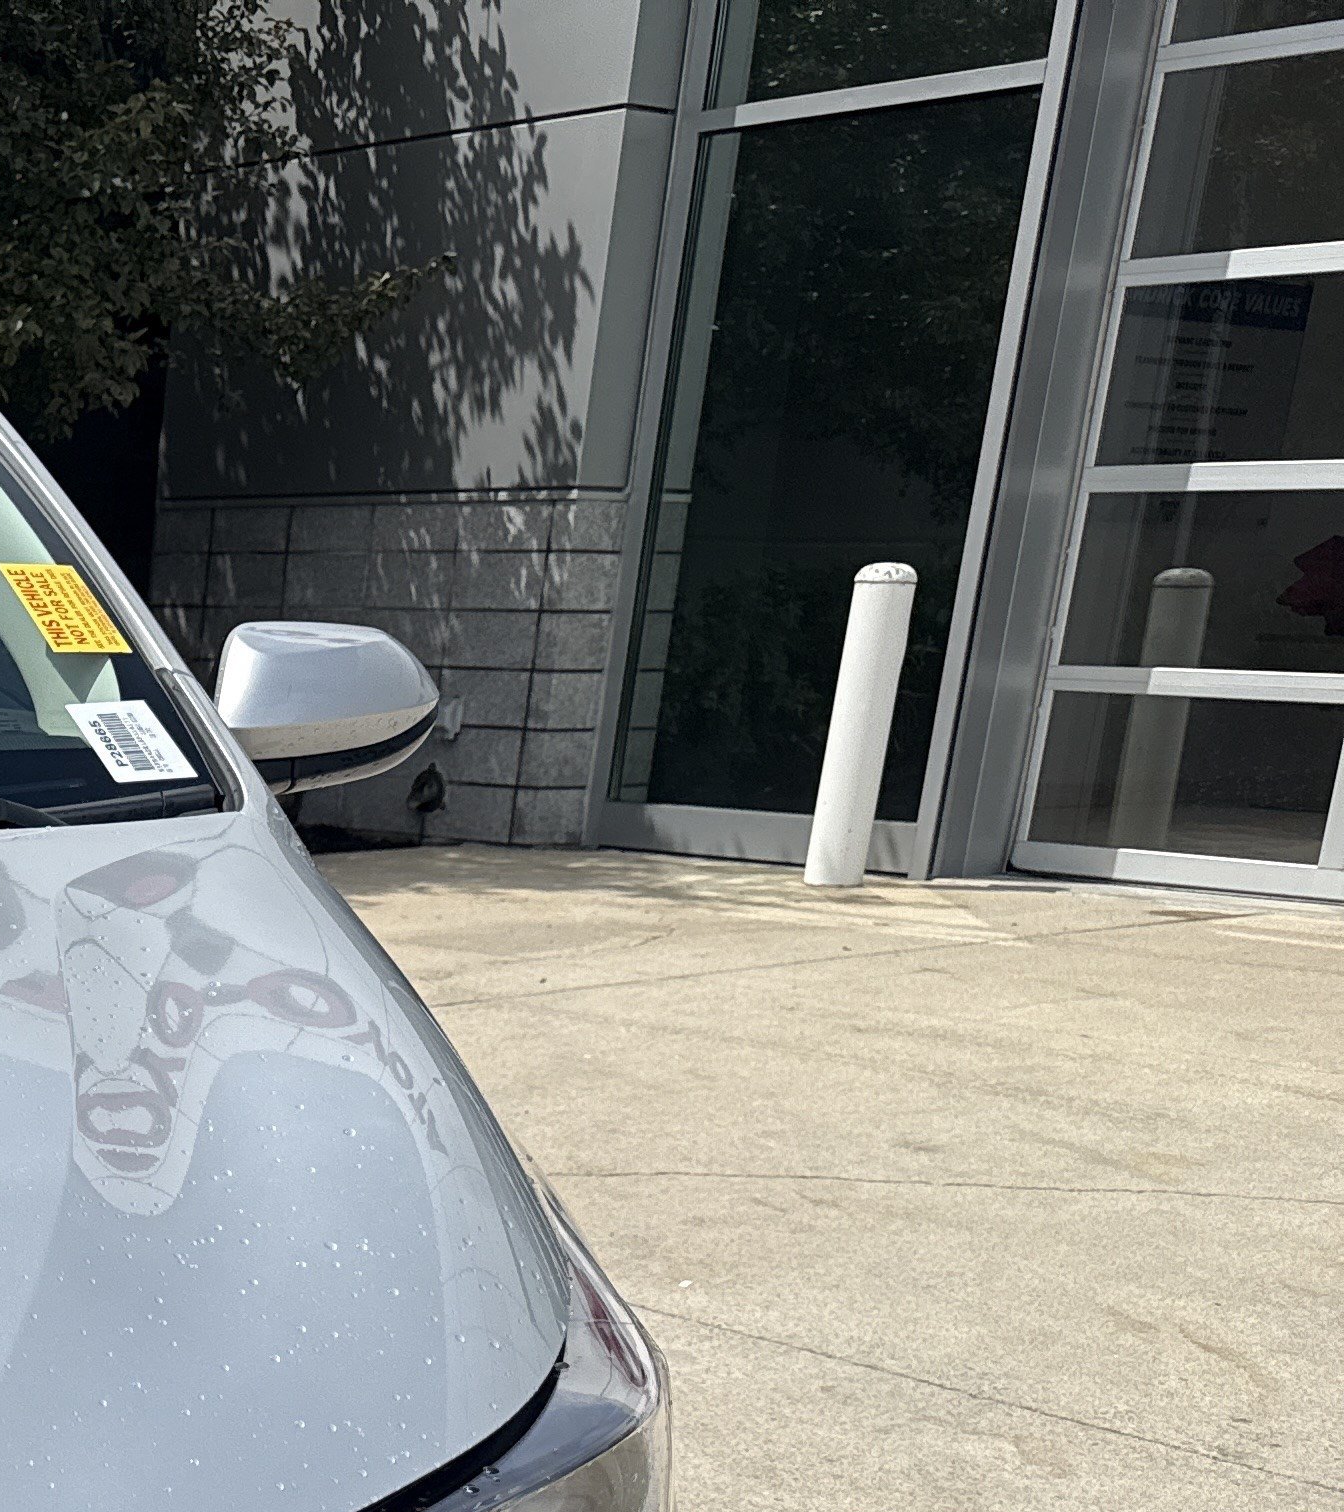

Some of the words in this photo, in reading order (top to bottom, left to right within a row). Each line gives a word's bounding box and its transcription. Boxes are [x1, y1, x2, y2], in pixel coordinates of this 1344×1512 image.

[1199, 288, 1242, 311] CORE
[1244, 293, 1304, 317] VALUES
[7, 569, 52, 617] VEHICLE
[30, 571, 58, 597] SALE
[50, 600, 74, 621] FOR
[42, 620, 73, 648] THIS
[65, 624, 90, 645] NOT
[88, 720, 129, 768] P28665
